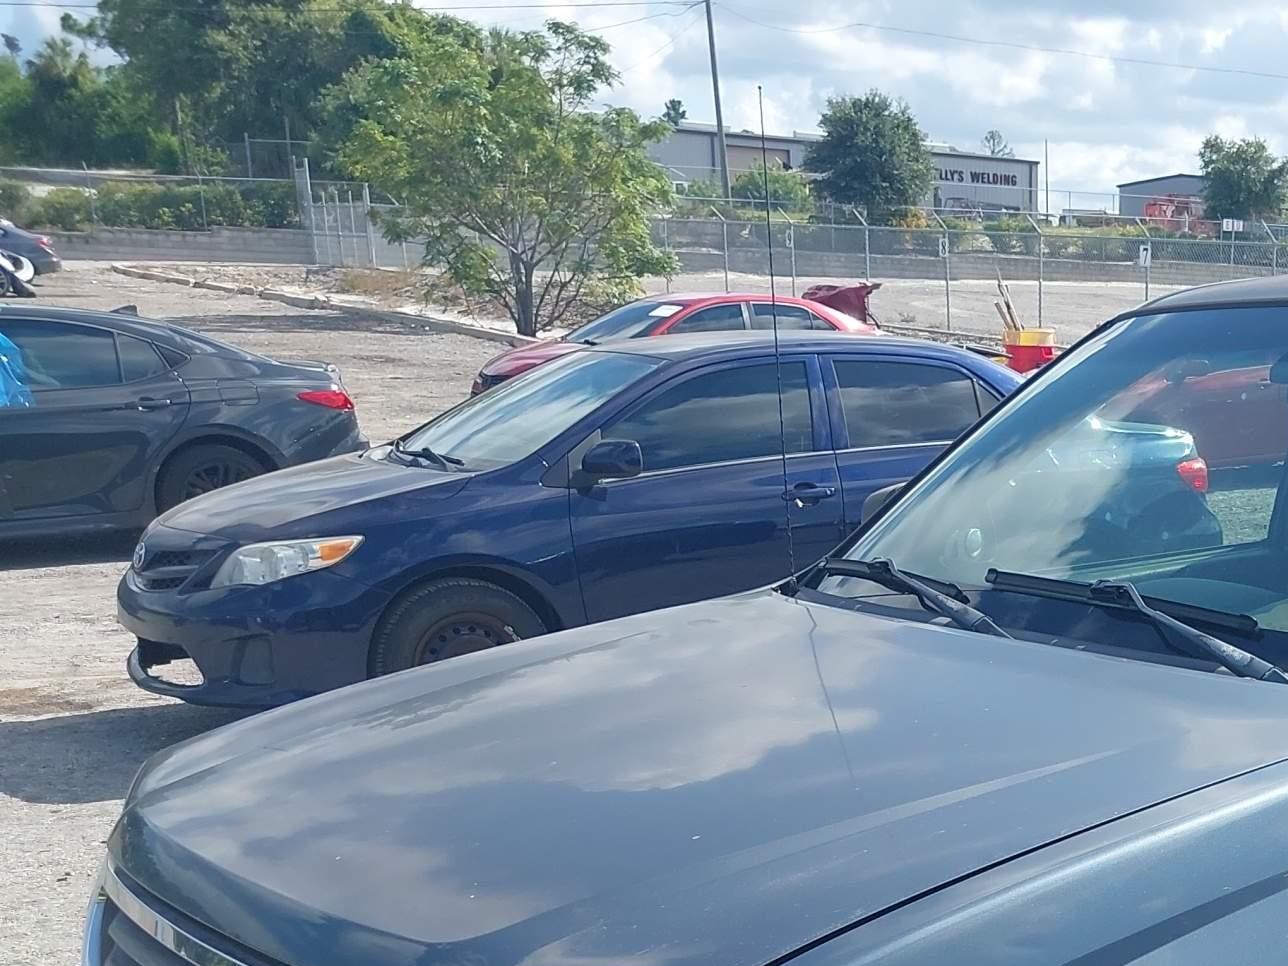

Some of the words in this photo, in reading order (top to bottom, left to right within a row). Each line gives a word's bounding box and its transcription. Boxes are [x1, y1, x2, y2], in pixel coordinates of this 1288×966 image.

[970, 171, 1018, 187] WELDING
[941, 240, 947, 256] 8
[1142, 247, 1149, 265] 7
